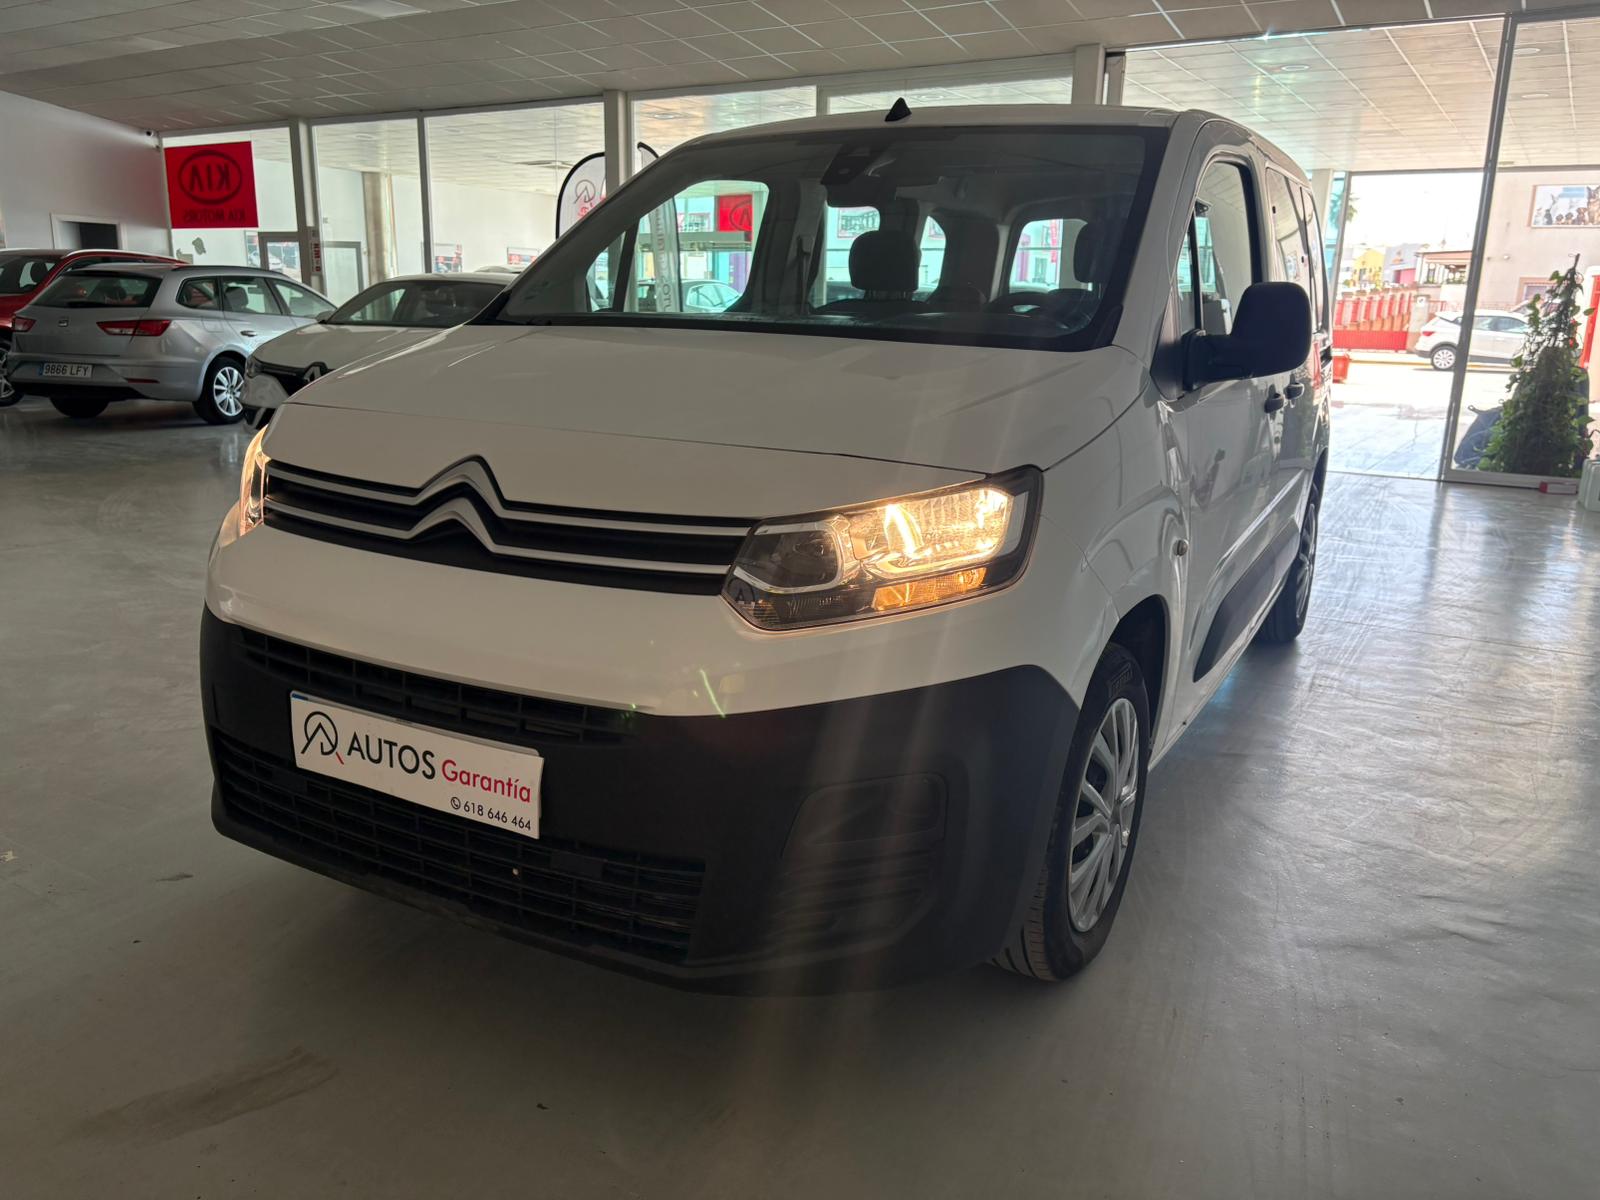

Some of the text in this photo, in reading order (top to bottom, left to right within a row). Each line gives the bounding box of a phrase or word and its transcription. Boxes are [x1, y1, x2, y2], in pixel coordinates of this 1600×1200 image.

[45, 364, 89, 377] 9866 LFY
[347, 731, 531, 803] AUTOS Garantía
[463, 801, 531, 831] 618 646 464
